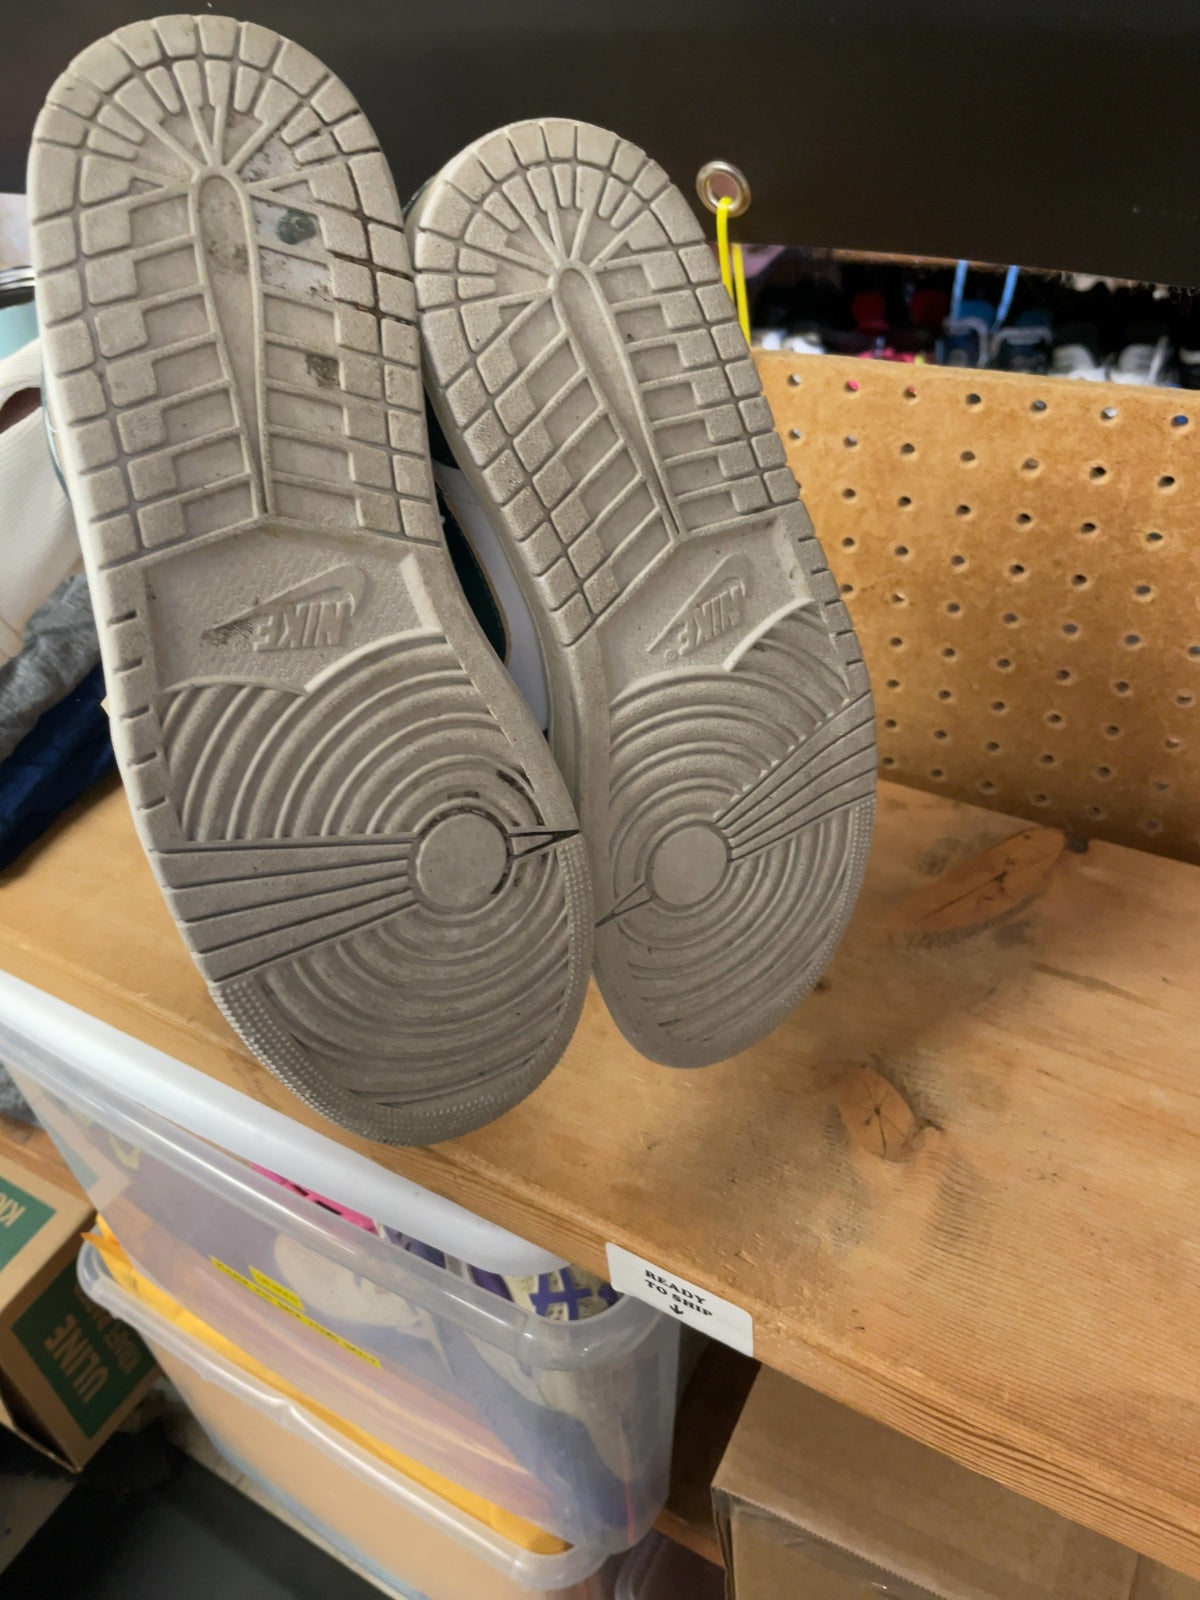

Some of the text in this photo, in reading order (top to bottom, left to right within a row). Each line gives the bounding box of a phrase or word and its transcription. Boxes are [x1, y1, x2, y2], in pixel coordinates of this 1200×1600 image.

[252, 600, 347, 652] NIKE
[677, 585, 742, 656] NIKE
[644, 1269, 706, 1304] READY
[645, 1279, 713, 1317] TO SHIP
[43, 1314, 109, 1403] ULINE
